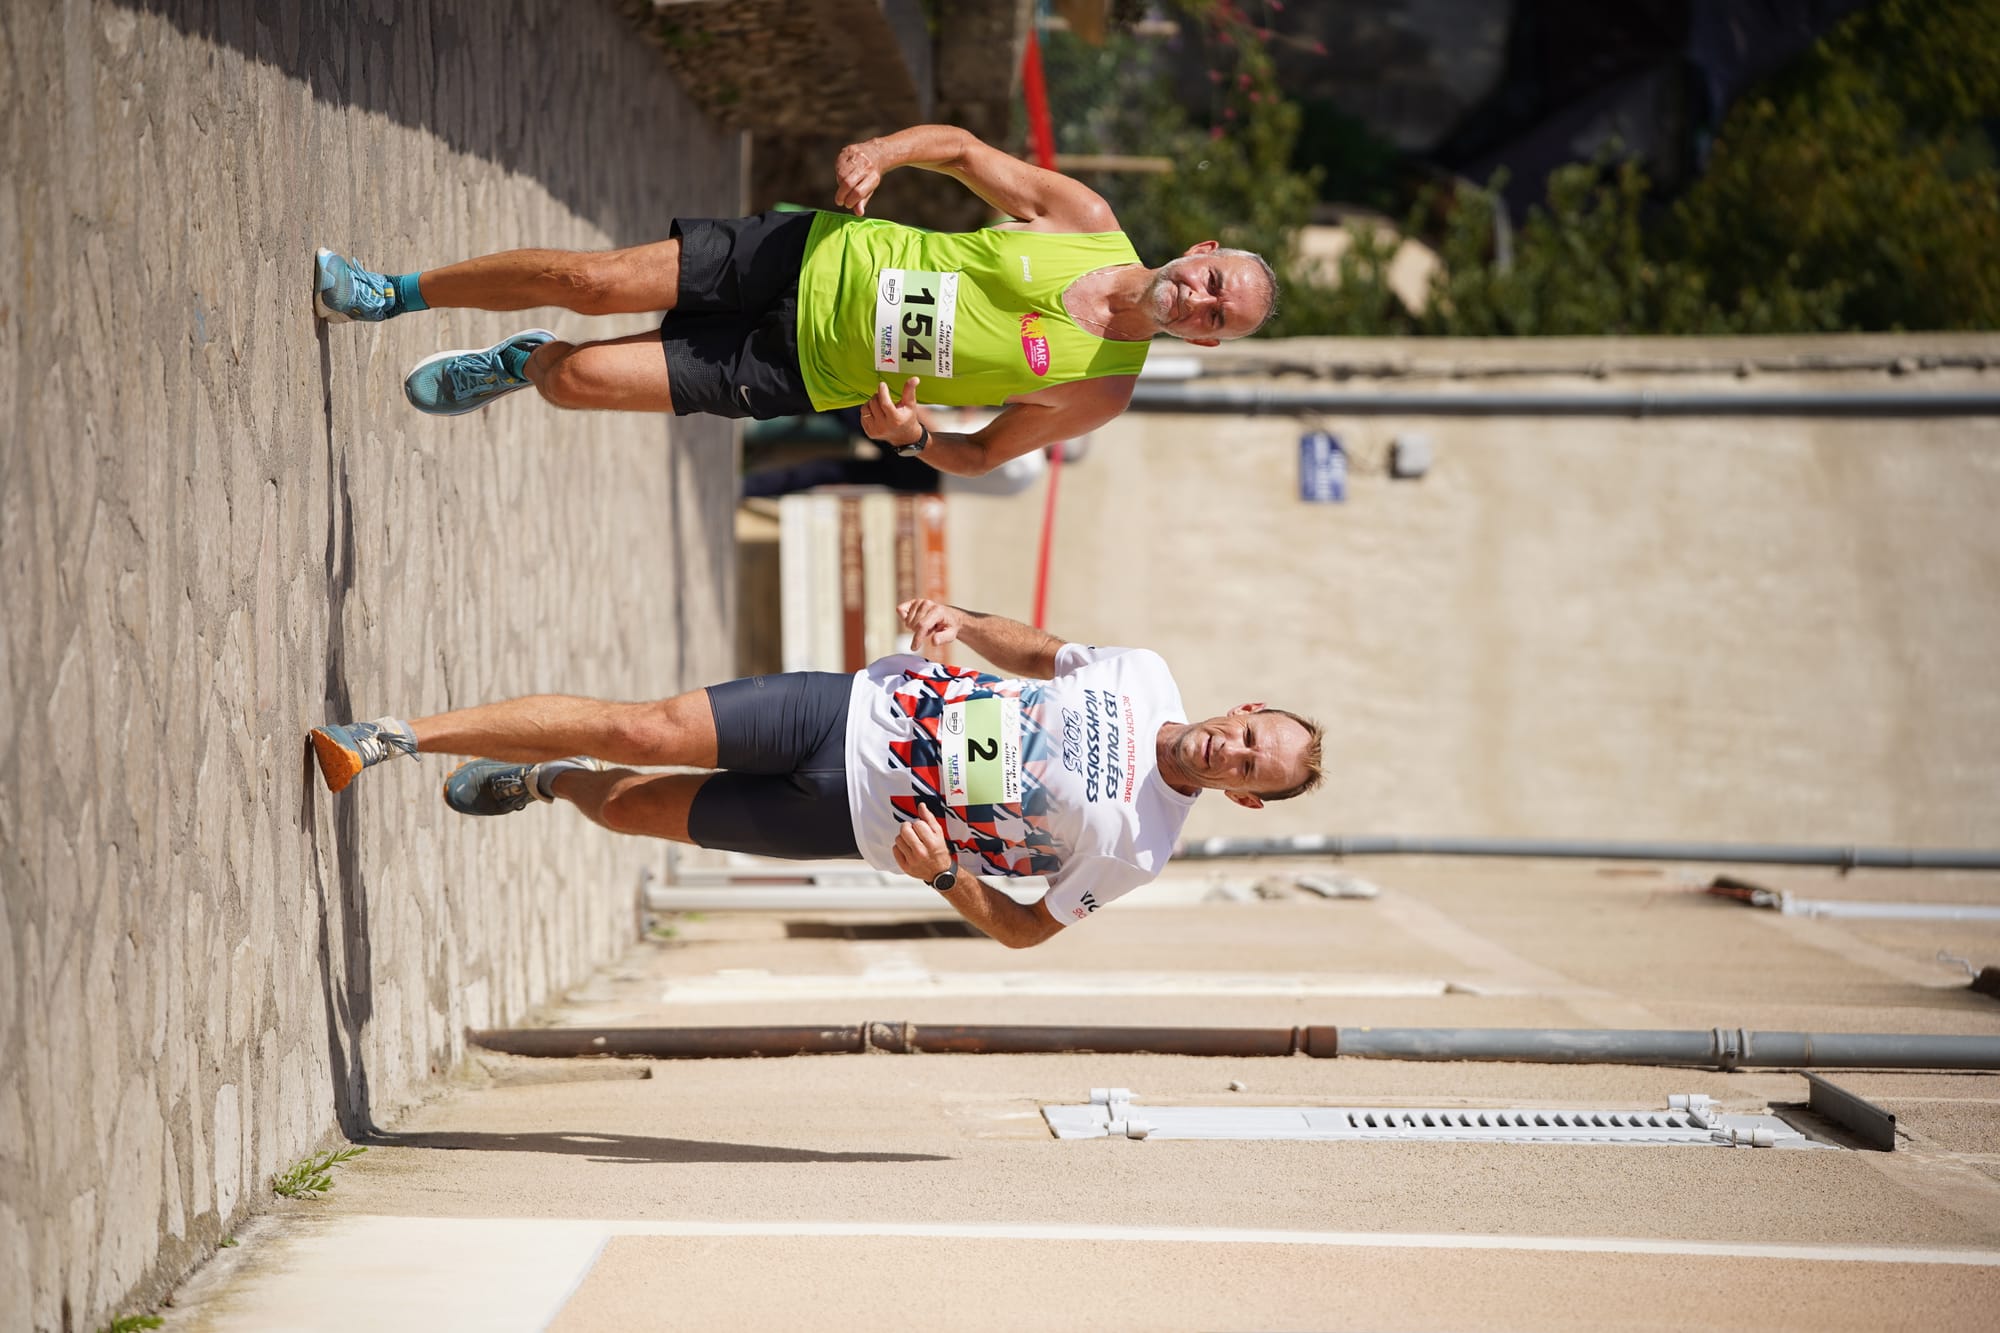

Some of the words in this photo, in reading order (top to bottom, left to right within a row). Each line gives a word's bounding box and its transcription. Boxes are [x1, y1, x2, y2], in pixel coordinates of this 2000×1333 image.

[885, 325, 893, 355] TUFF'S
[901, 288, 935, 362] 154
[1036, 339, 1047, 367] MARC
[1103, 691, 1118, 718] LES
[1125, 707, 1135, 736] VICHY
[968, 738, 998, 762] 2
[1062, 708, 1083, 775] 2025
[952, 754, 960, 785] TUFF'S
[1105, 723, 1123, 799] FOULÉES
[1124, 737, 1135, 803] ATHLETISME
